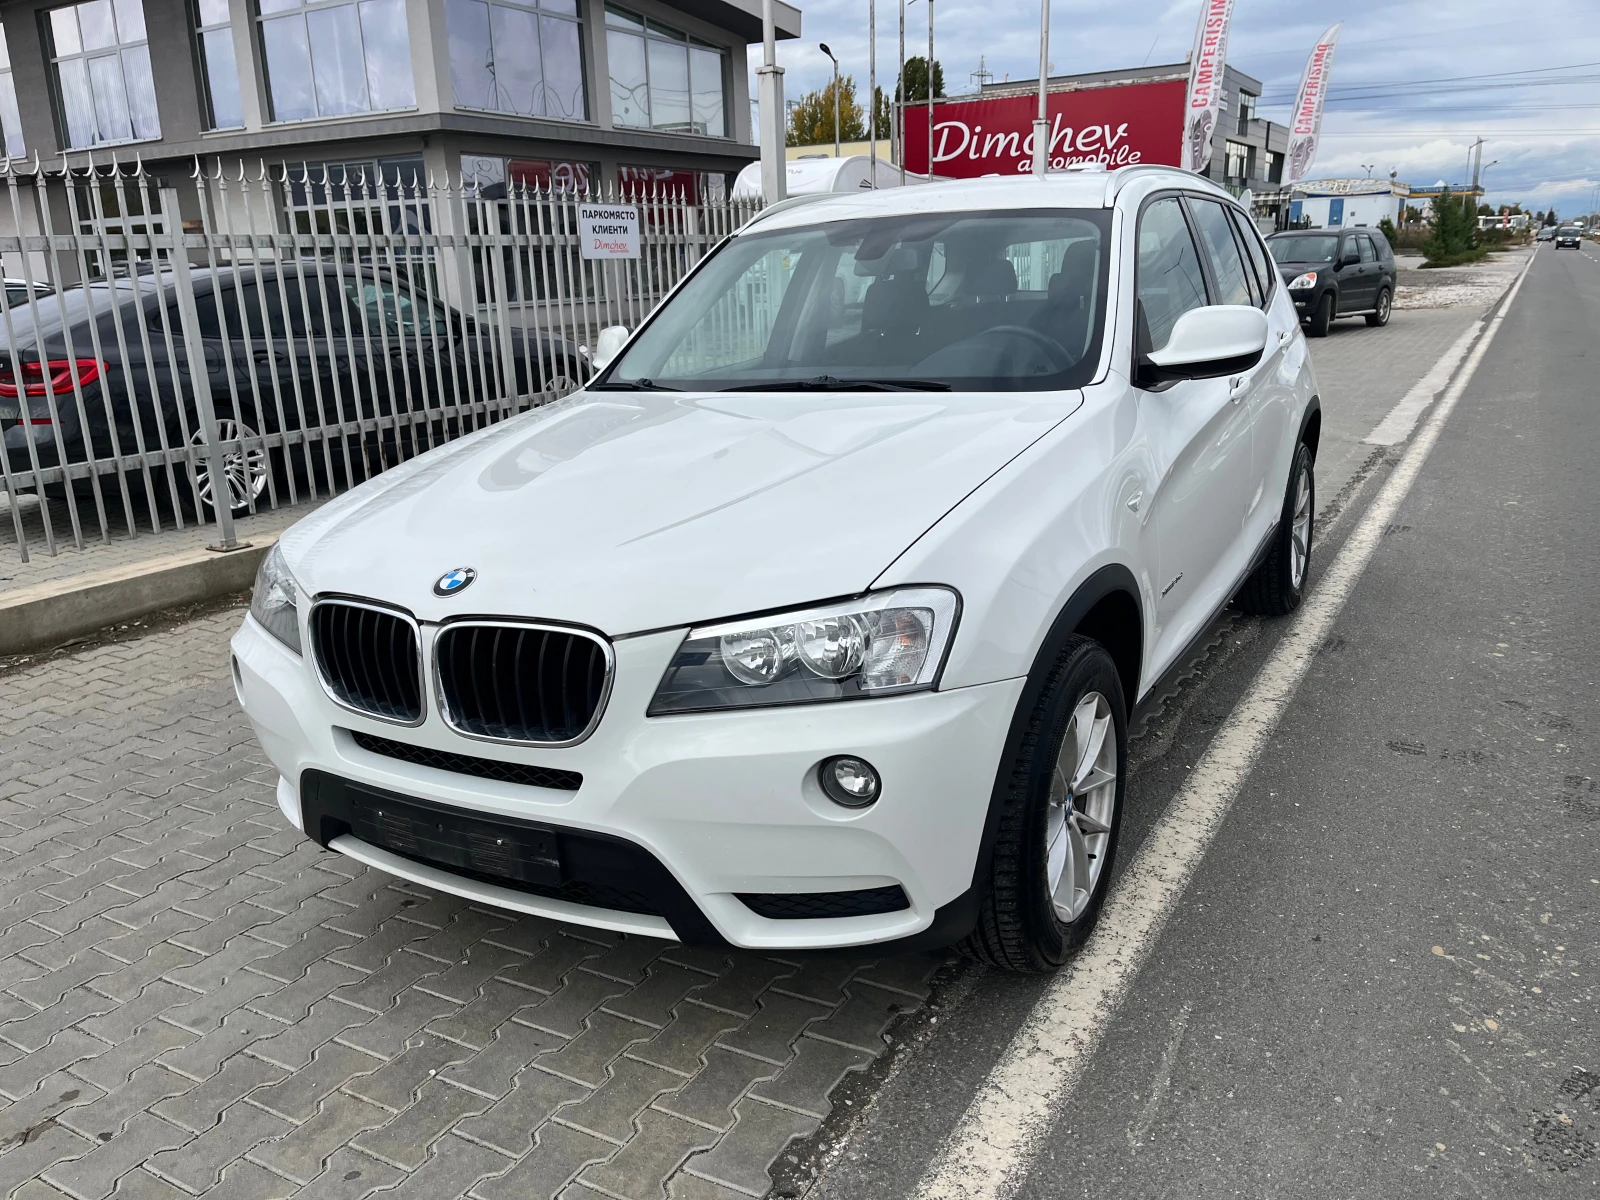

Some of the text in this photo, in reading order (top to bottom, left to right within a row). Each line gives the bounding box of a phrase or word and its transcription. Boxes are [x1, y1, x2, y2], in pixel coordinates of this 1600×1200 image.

[1294, 43, 1330, 134] CAMPERISIMO
[1017, 145, 1142, 172] aomobile
[582, 210, 635, 220] ПАРКОМЯСТО
[592, 225, 628, 234] КЛИЕНТИ
[594, 238, 627, 250] Dimchev
